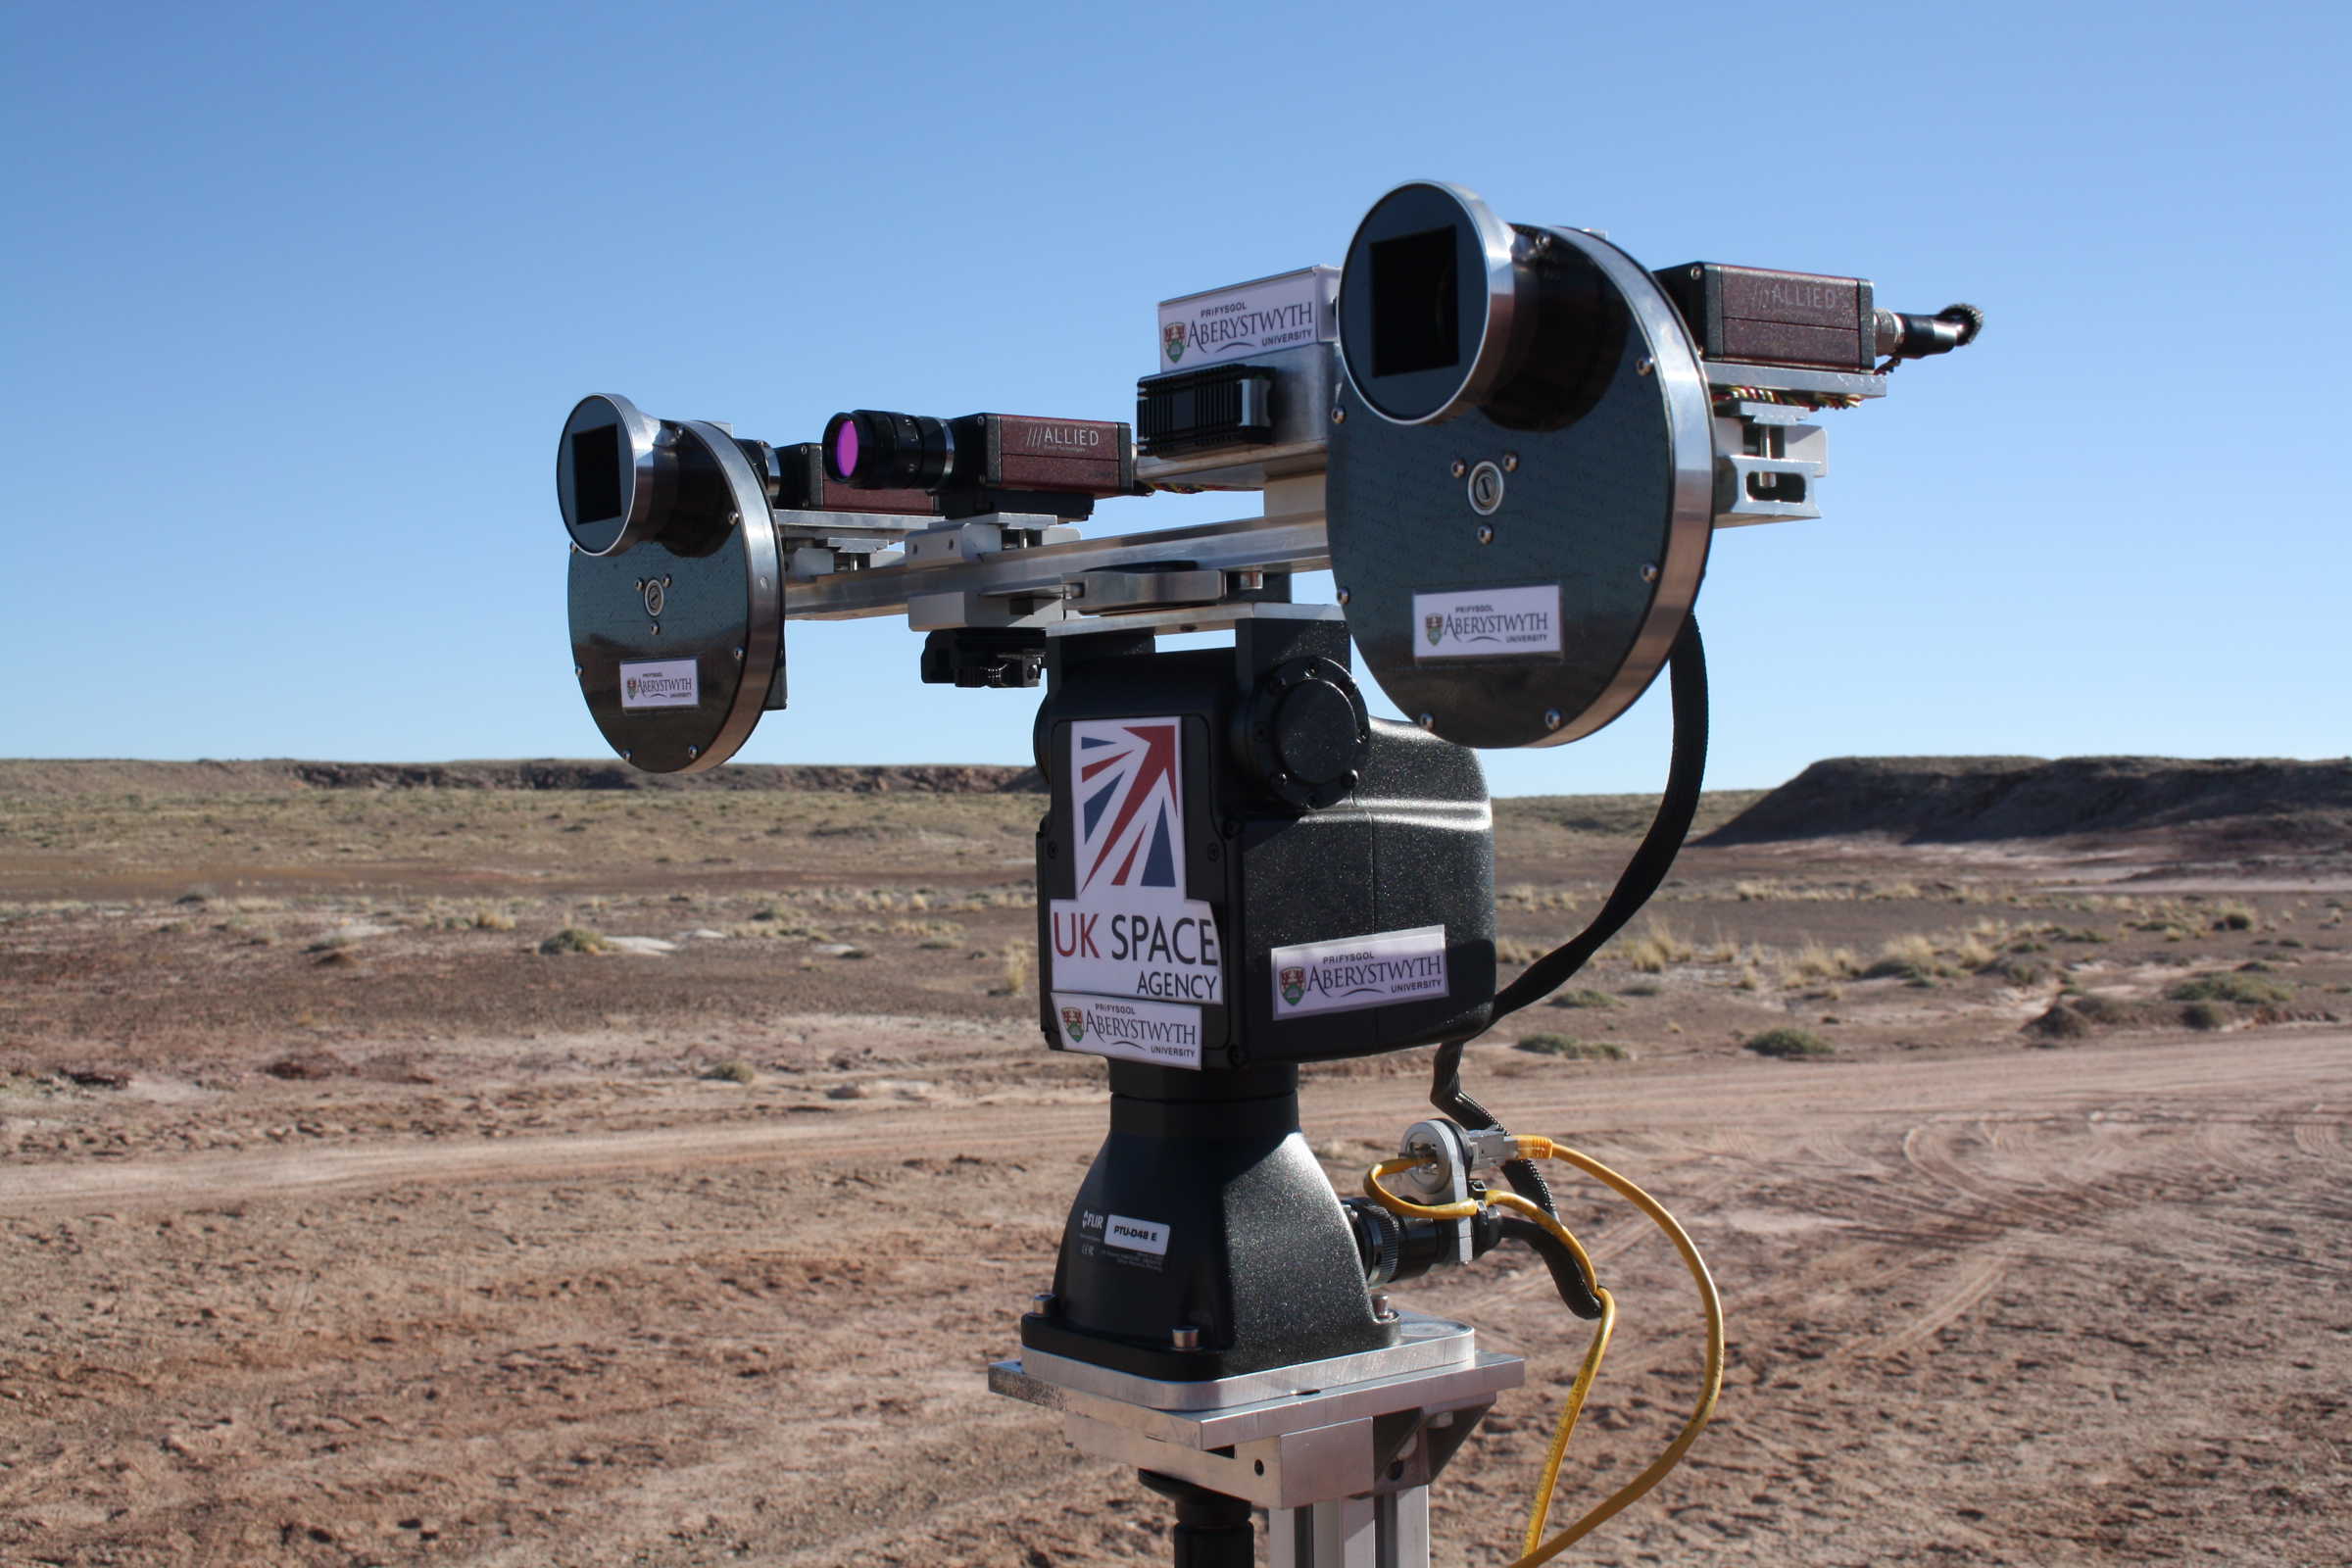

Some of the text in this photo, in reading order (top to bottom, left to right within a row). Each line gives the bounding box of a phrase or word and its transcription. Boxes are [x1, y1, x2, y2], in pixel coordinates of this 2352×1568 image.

[1200, 301, 1248, 318] PRIFYSGOL
[1186, 301, 1313, 353] ABERYSTWYTH
[1261, 328, 1313, 346] UNIVERSITY
[1045, 426, 1099, 446] ALLIED
[1444, 612, 1547, 642] ABERYSTWYTH
[1506, 634, 1547, 643] UNIVERSITY
[638, 677, 692, 698] ABERYSTWYTH
[1054, 911, 1218, 966] UK SPACE
[1323, 951, 1375, 964] PRIFYSGOL
[1136, 971, 1217, 1000] AGENCY
[1307, 956, 1442, 998] ABERYSTWYTH
[1391, 979, 1442, 994] UNIVERSITY
[1095, 1003, 1136, 1014] PRIFYSGOL
[1085, 1010, 1196, 1045] ABERYSTWYTH
[1151, 1046, 1196, 1057] UNIVERSITY
[1088, 1213, 1103, 1230] FLIR
[1151, 1232, 1157, 1241] E
